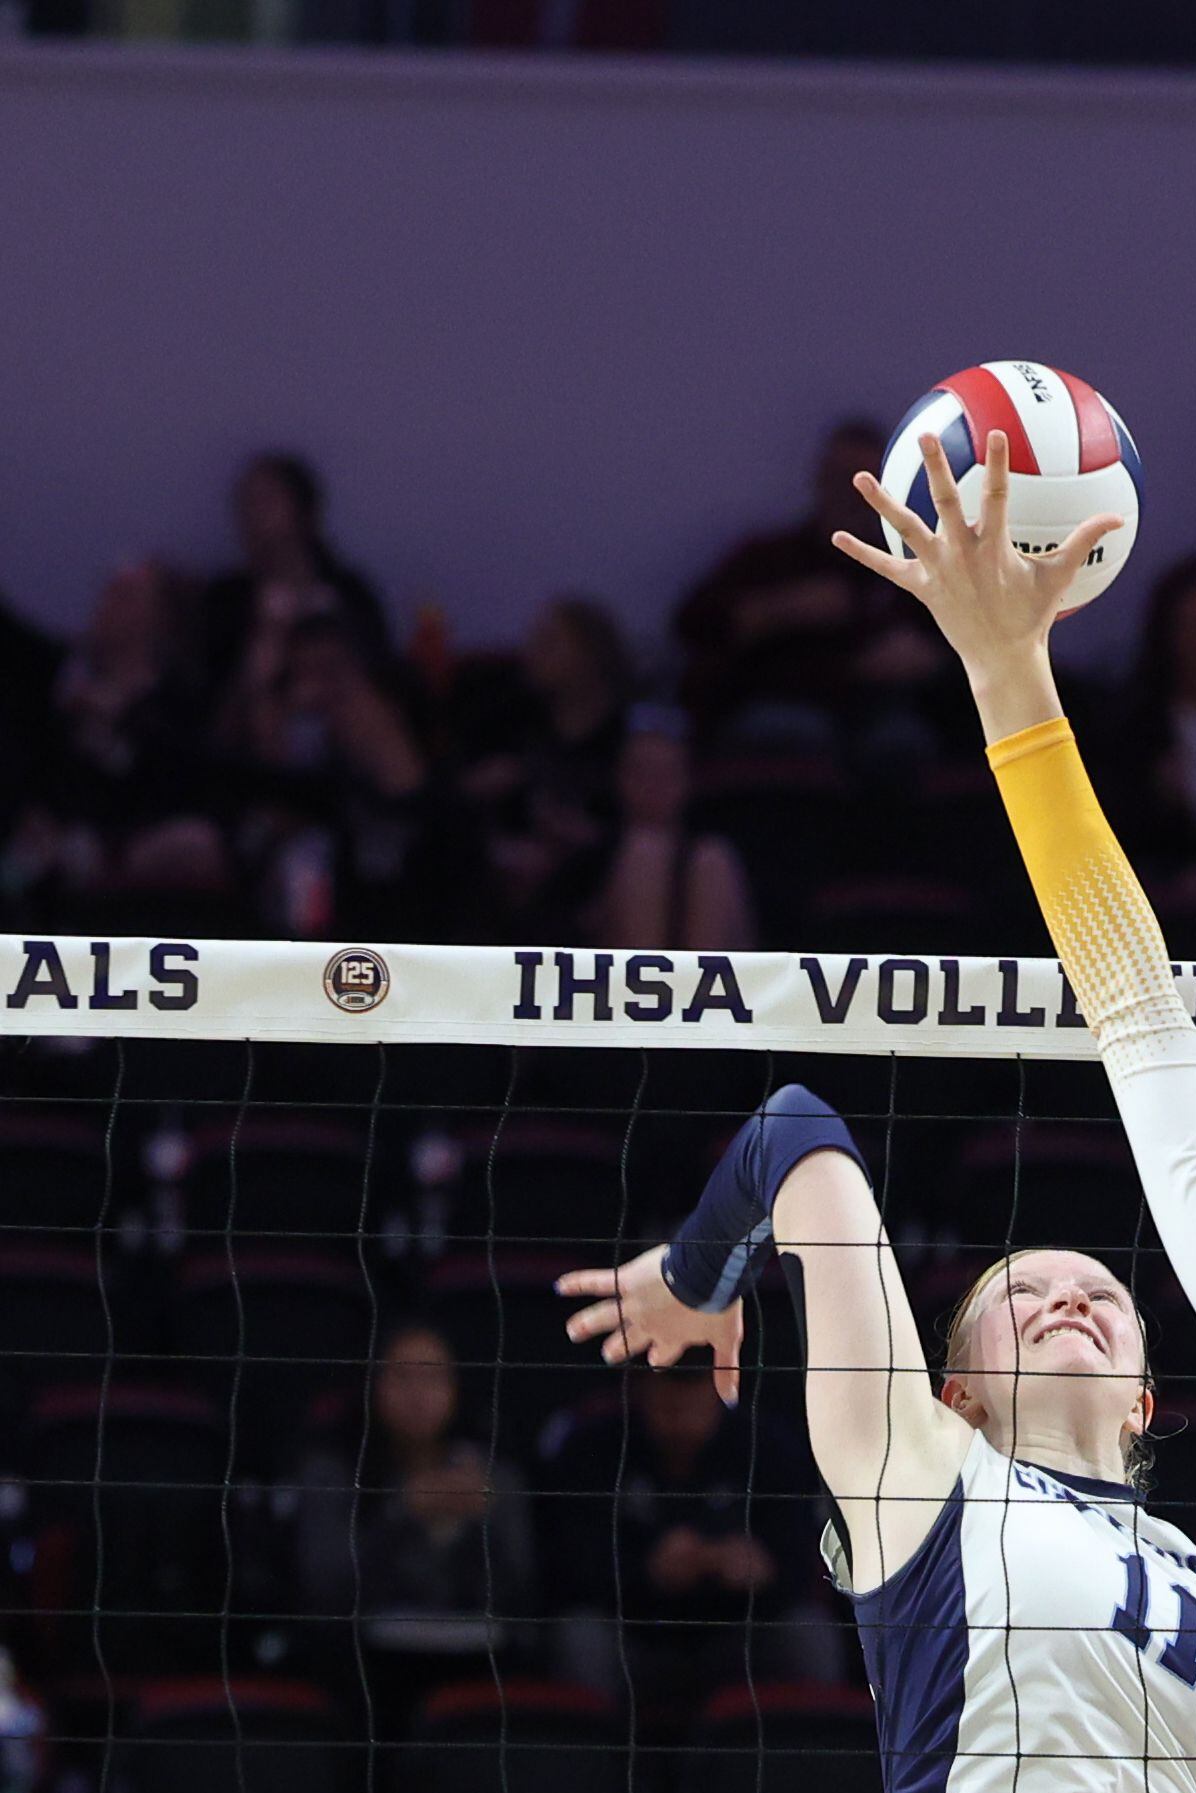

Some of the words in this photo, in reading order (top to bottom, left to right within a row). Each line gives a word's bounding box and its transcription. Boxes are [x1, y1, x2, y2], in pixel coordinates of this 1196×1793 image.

[5, 941, 200, 1011] ALS
[341, 961, 375, 985] 125
[512, 951, 754, 1024] IHSA
